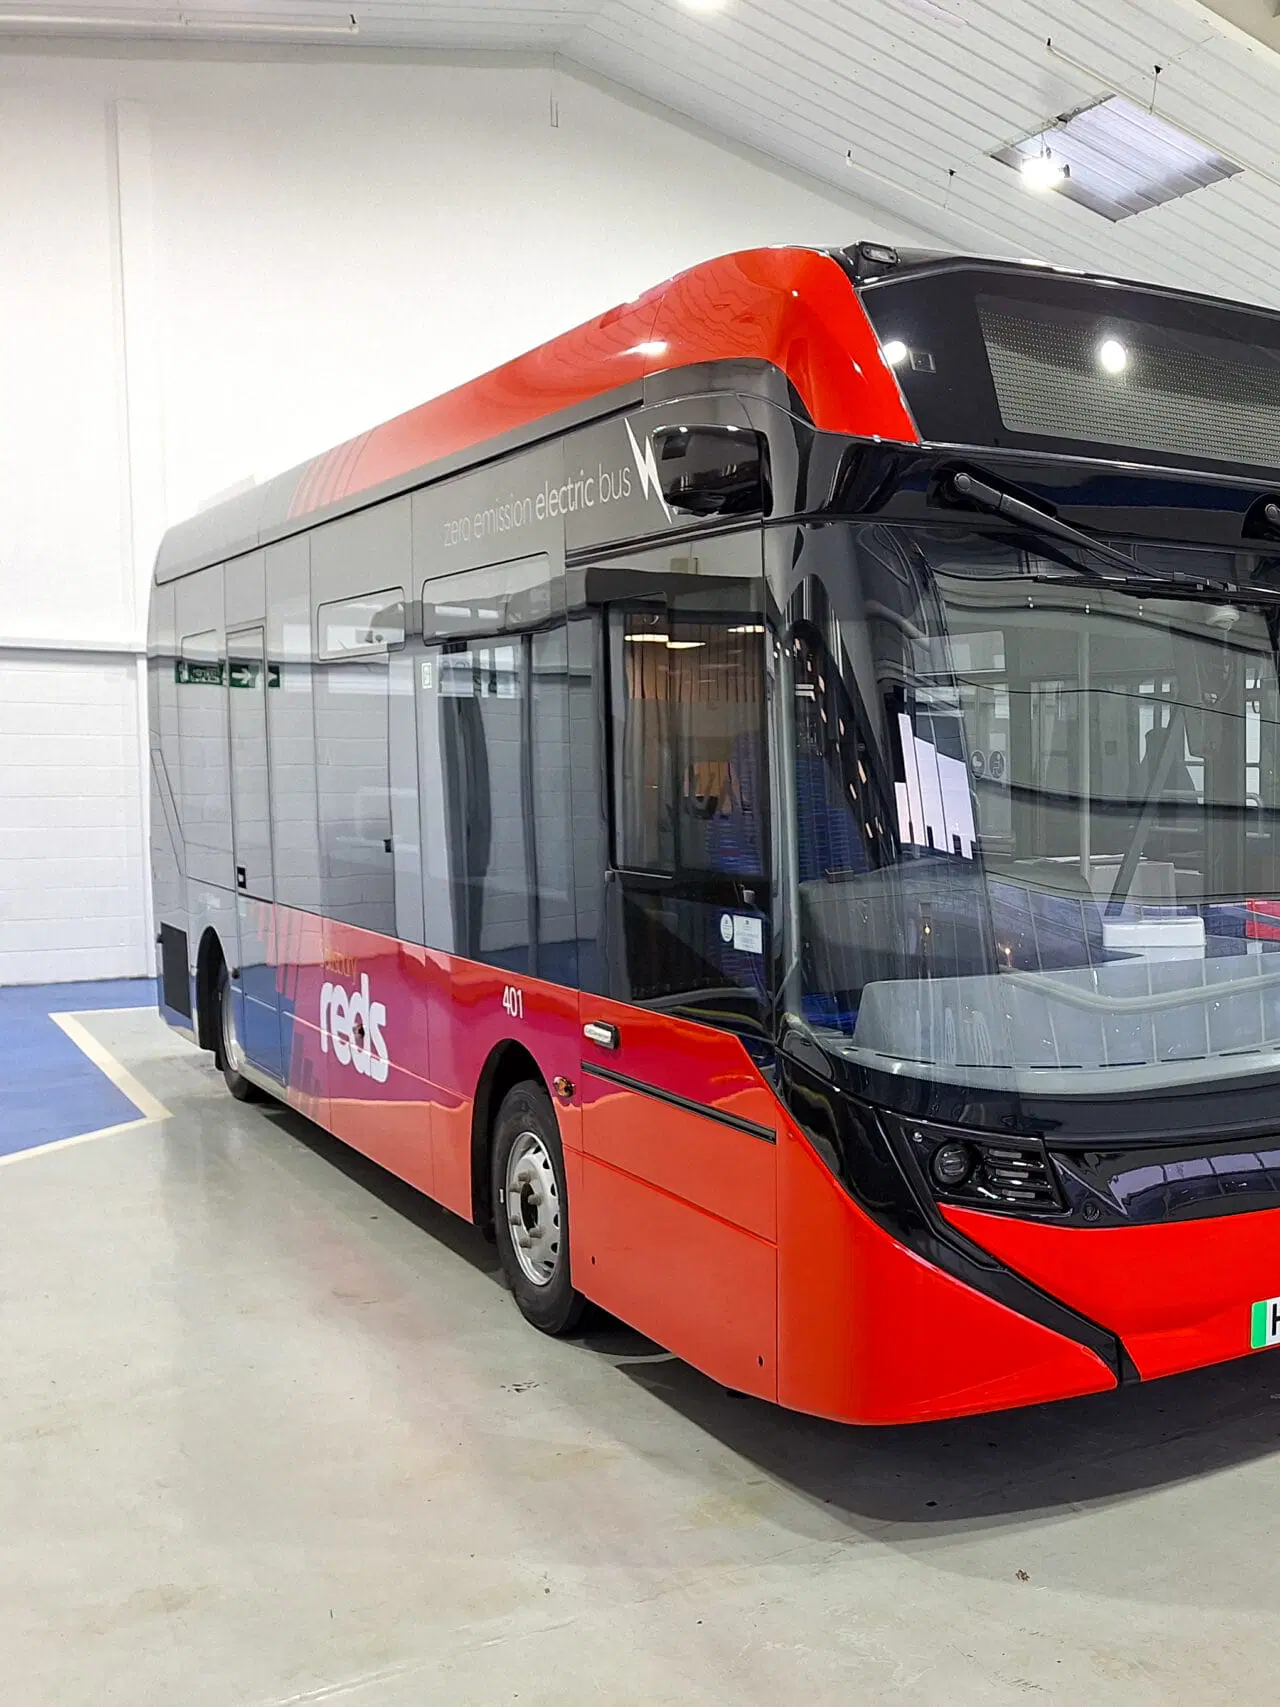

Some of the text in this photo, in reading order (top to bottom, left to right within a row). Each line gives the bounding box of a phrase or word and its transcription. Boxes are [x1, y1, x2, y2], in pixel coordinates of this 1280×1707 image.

[443, 463, 632, 547] zero emission electric bus
[320, 972, 389, 1084] reds
[502, 985, 524, 1019] 401
